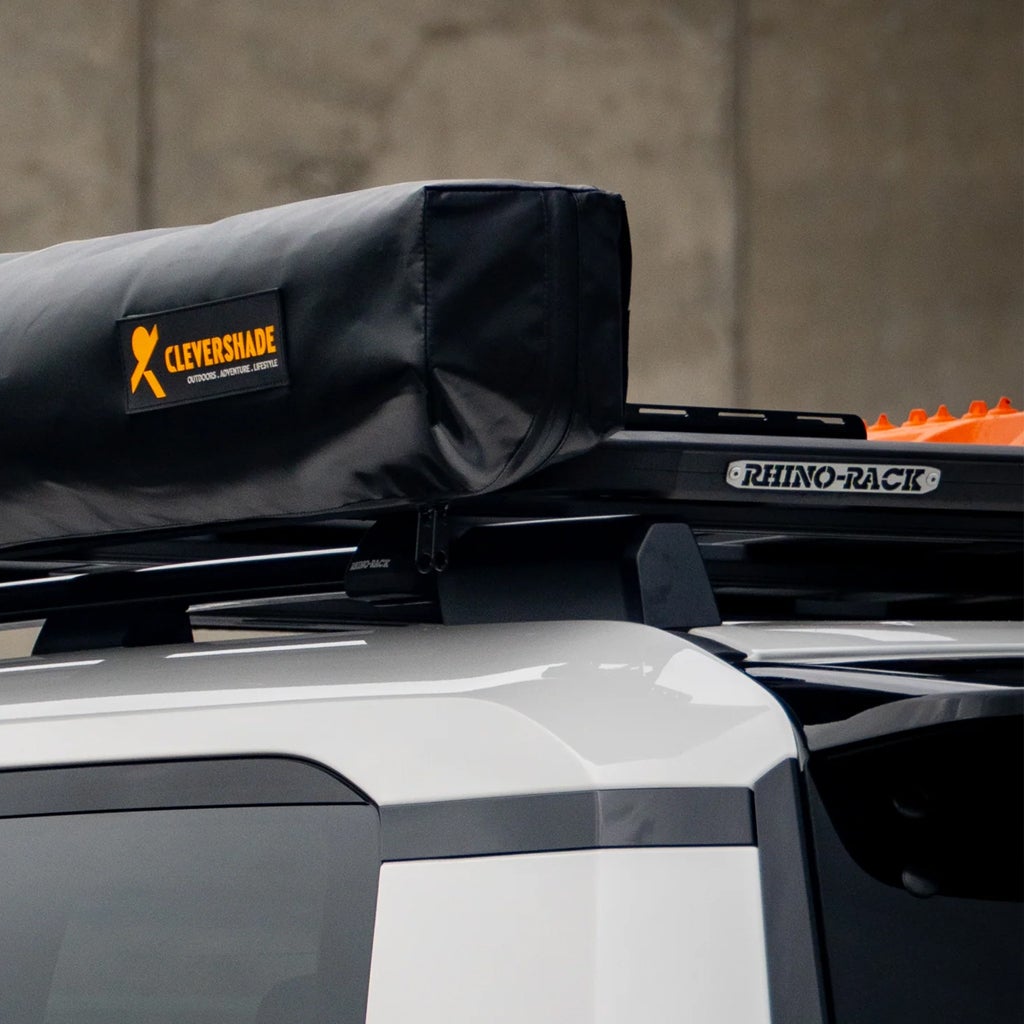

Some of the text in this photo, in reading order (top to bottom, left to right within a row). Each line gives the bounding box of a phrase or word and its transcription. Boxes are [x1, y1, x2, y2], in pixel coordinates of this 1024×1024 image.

[164, 325, 277, 374] CLEVERSHADE
[219, 364, 251, 378] ADVENTURE
[253, 358, 279, 371] LIFESTYLE
[741, 463, 926, 492] RHINO-RACK
